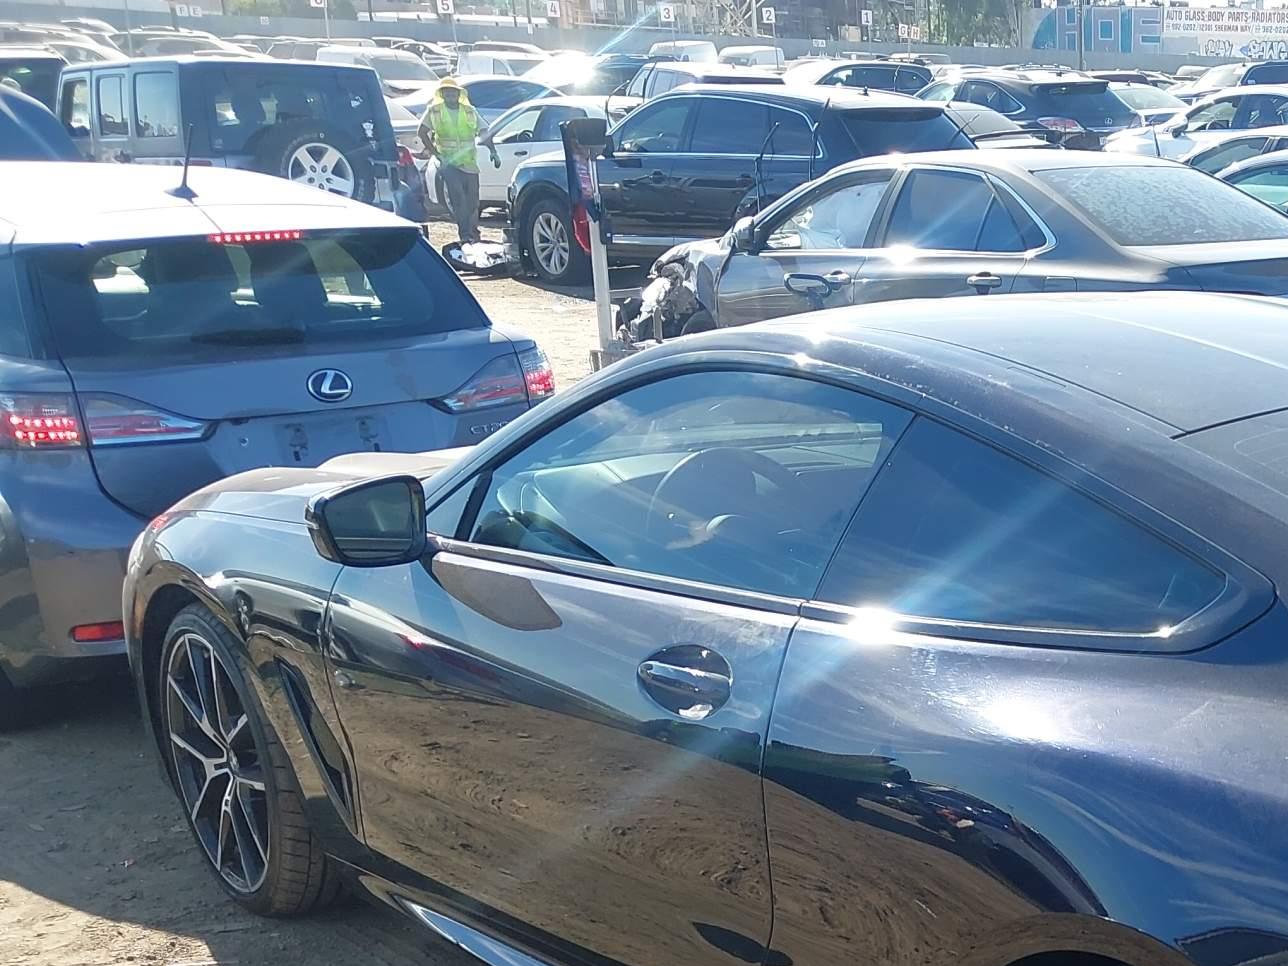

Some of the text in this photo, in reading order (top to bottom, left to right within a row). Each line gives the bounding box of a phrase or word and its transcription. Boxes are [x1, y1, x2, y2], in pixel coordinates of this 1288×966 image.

[441, 0, 450, 11] 5
[549, 2, 557, 15] 4
[663, 7, 671, 19] 3
[765, 10, 773, 22] 2
[863, 12, 870, 23] 1
[1166, 10, 1182, 21] AUTO
